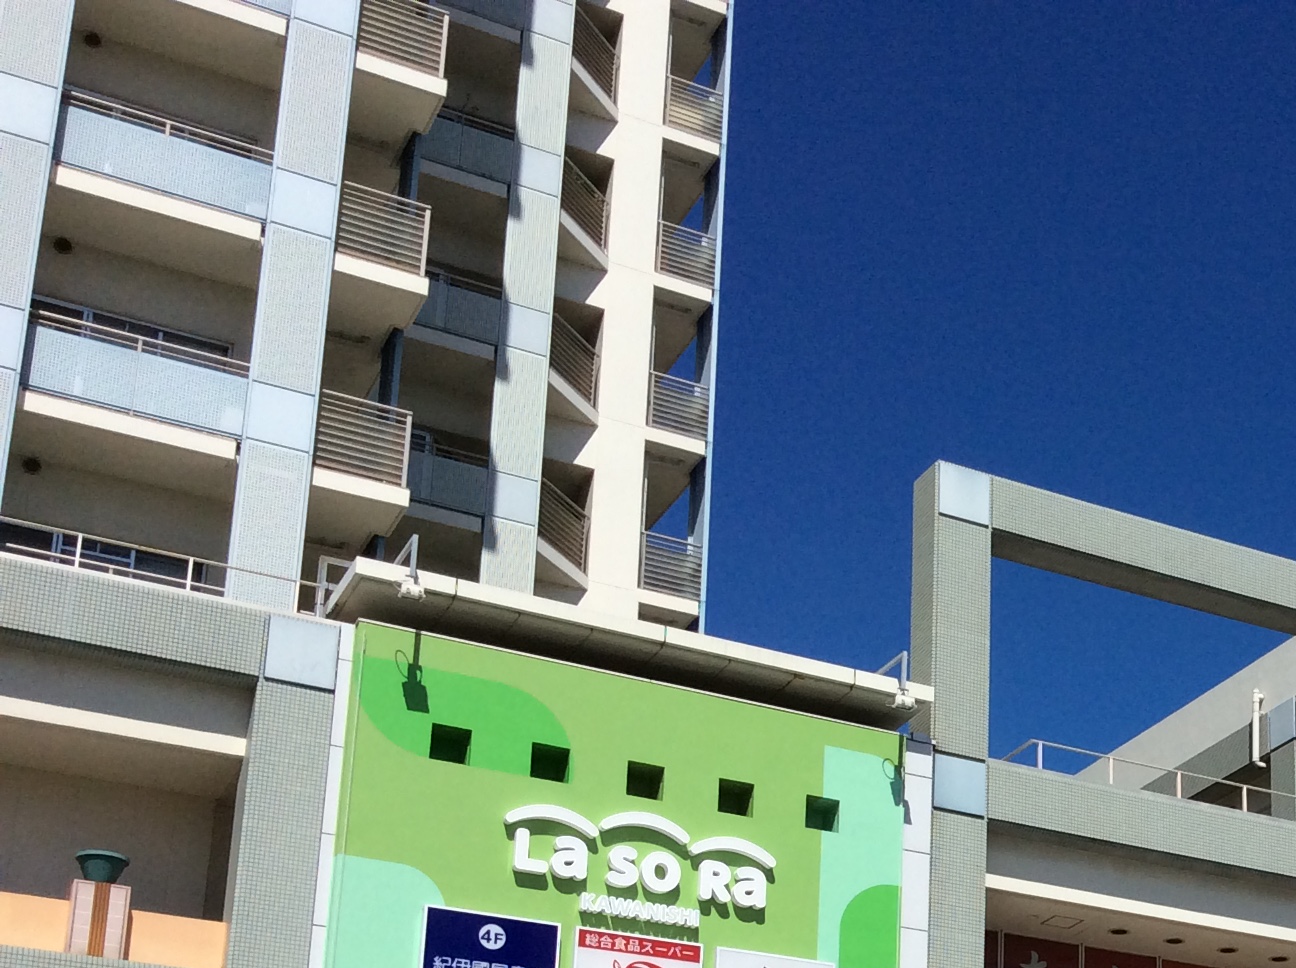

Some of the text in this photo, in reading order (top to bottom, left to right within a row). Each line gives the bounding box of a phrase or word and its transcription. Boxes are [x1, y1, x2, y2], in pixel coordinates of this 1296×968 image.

[512, 827, 589, 882] La
[698, 859, 768, 910] Ra
[579, 891, 700, 927] KAWANISHI
[480, 929, 504, 945] 4F
[585, 932, 694, 957] 総合食品スーパー
